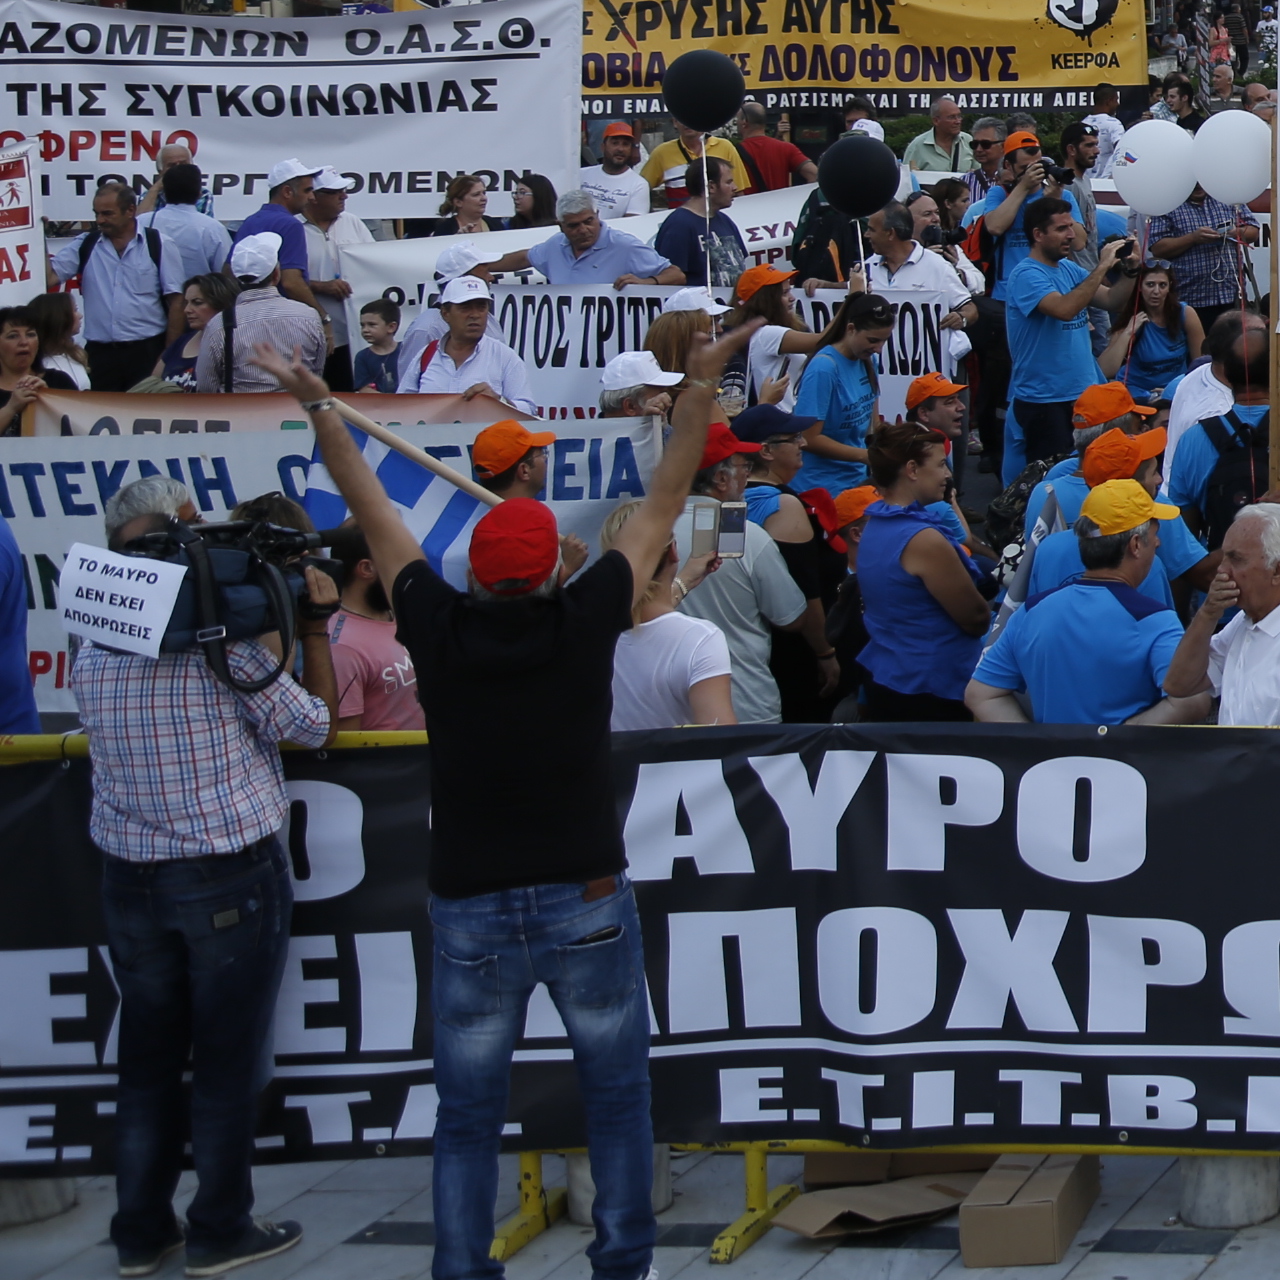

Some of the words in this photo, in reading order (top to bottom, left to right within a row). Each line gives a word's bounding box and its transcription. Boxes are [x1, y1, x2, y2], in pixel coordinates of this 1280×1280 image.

[345, 17, 551, 56] Ο.Α.Σ.Θ.
[583, 45, 667, 90] ΟΒΙΑ
[760, 42, 1019, 83] ΔΟΛΟΦΟΝΟΥΣ
[1051, 51, 1120, 71] ΚΕΕΡΦΑ
[6, 83, 106, 117] ΤΗΣ
[126, 77, 499, 119] ΣΥΓΚΟΙΝΩΝΙΑΣ
[78, 557, 98, 573] ΤΟ
[100, 562, 159, 585] ΜΑΥΡΟ
[75, 586, 105, 603] ΔΕΝ
[109, 593, 146, 612] ΕΧΕΙ
[64, 608, 153, 640] ΑΠΟΧΡΩΣΕΙΣ
[625, 750, 1148, 883] ΑΥΡΟ
[0, 931, 419, 1068] ΕΕΙ
